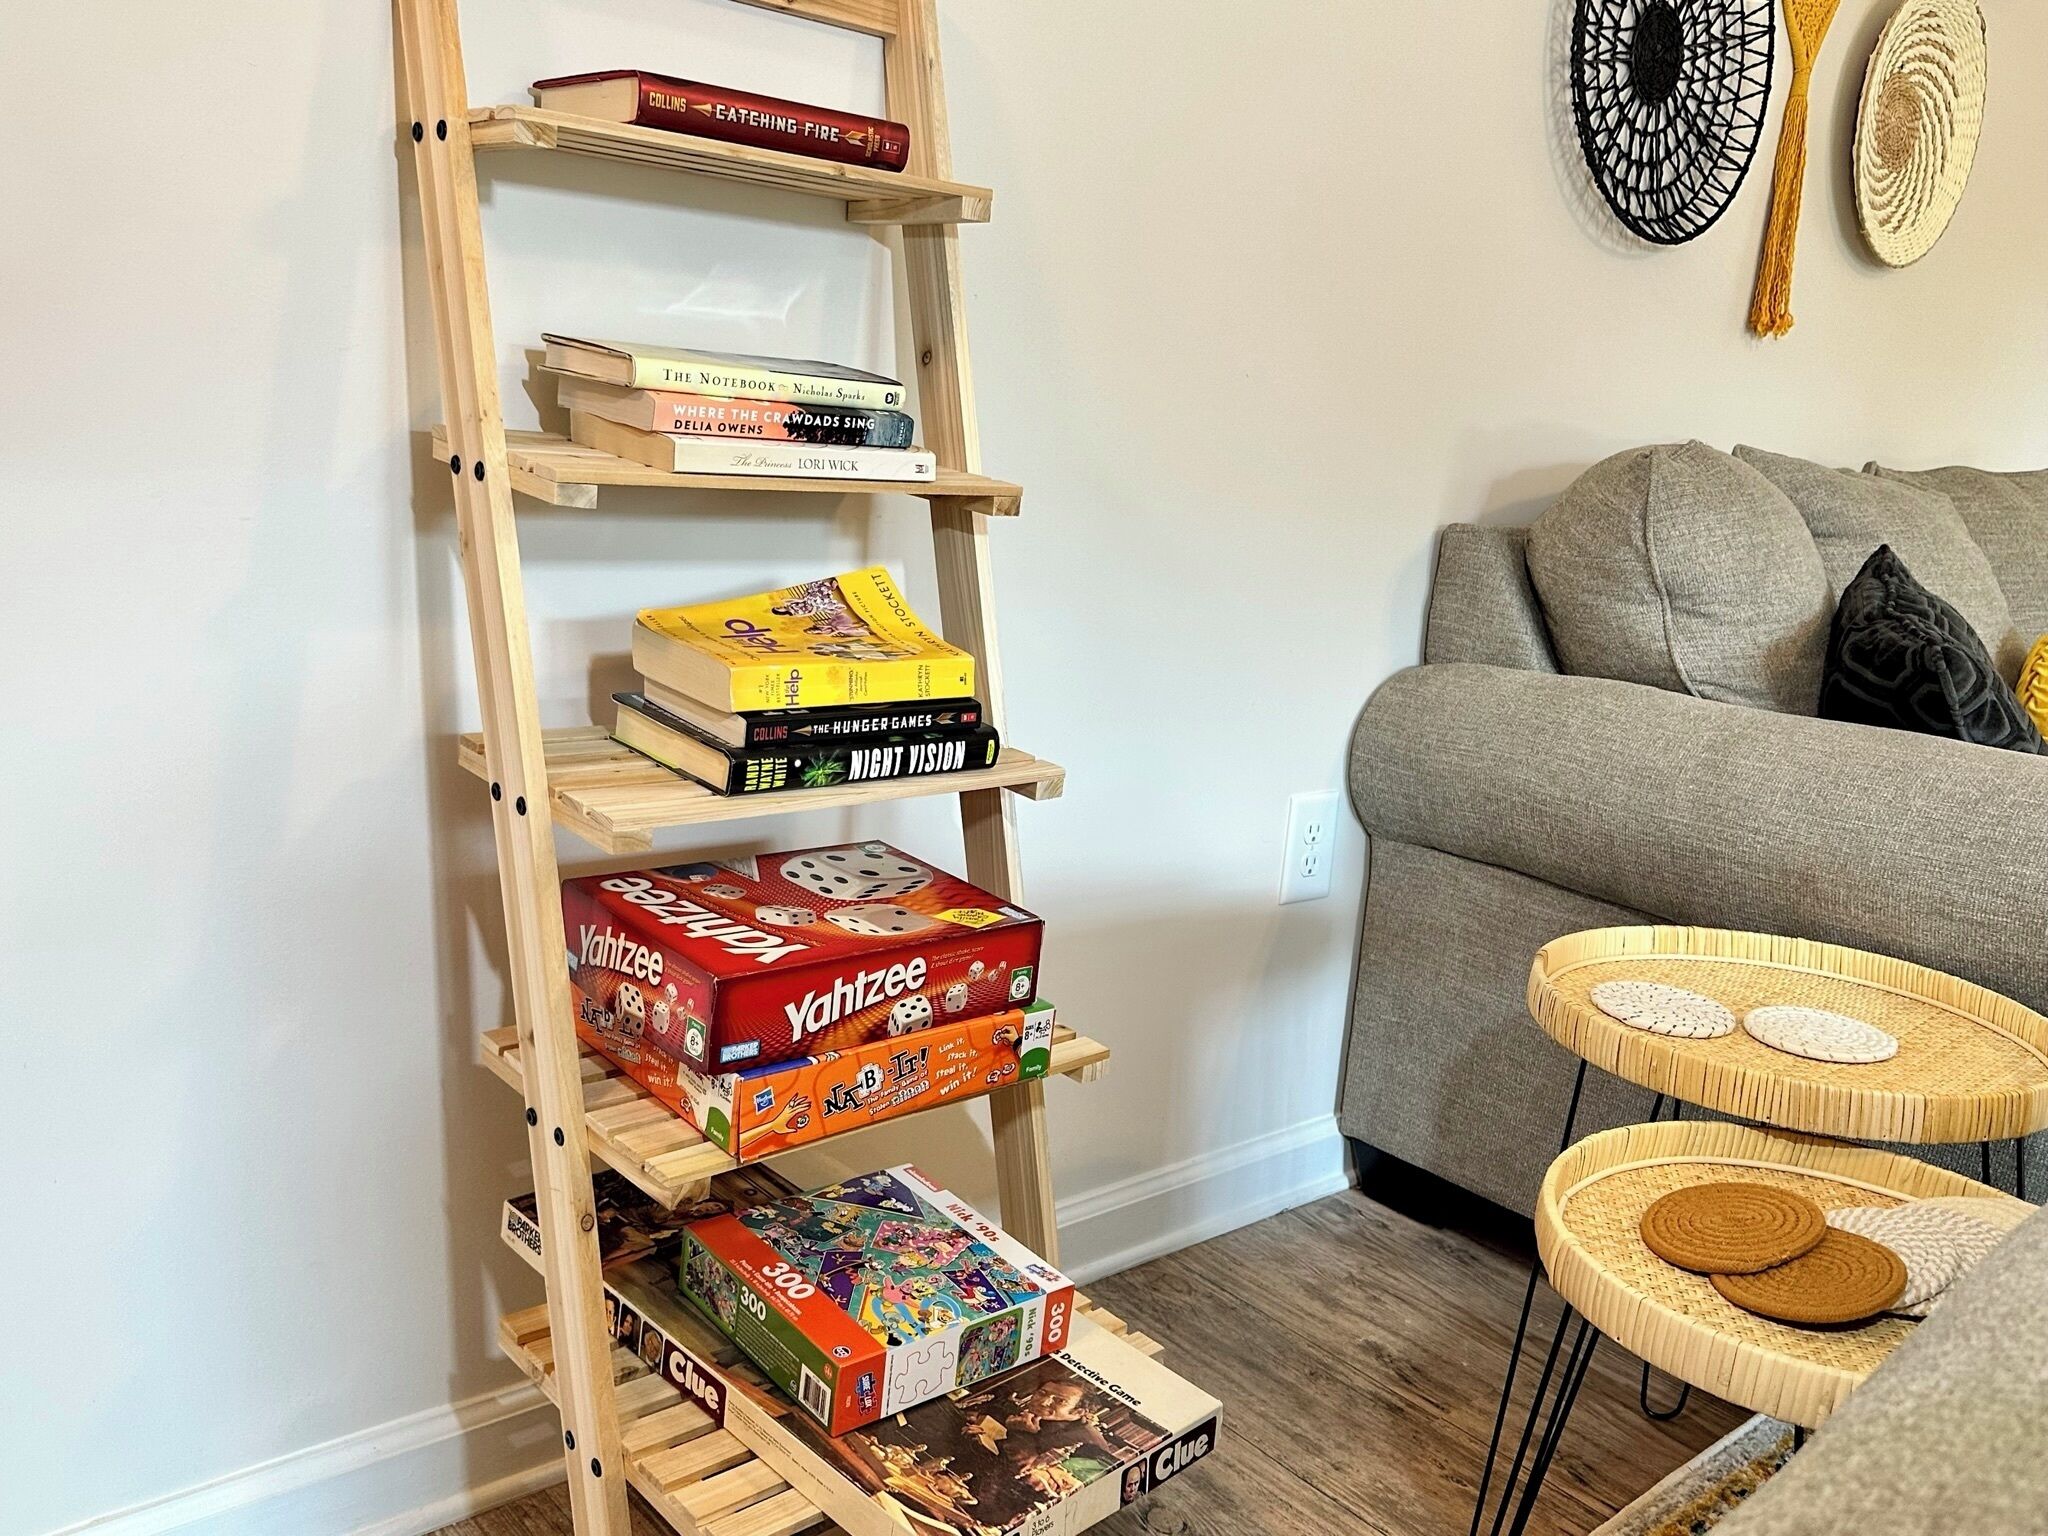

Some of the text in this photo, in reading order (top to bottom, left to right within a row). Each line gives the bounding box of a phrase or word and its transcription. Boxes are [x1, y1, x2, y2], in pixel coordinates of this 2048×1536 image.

[649, 91, 687, 112] COLLINS
[716, 104, 839, 142] CATCHING FIRE
[663, 369, 775, 392] THE NOTEBOOK
[793, 383, 865, 401] Nicholas Sparks
[673, 404, 875, 430] WHERE THE CRAWDADS SING
[674, 420, 763, 435] DELIA OWENS
[730, 452, 792, 469] The Princess
[798, 458, 859, 472] LORI WICK
[870, 574, 916, 627] STOCKETT
[719, 619, 800, 653] Help
[915, 631, 962, 656] KATHRYN
[784, 669, 803, 706] Help
[753, 725, 788, 741] COLLINS
[813, 714, 932, 734] THE HUNGER GAMES
[758, 757, 774, 790] WAYNE
[772, 757, 787, 788] WHITE
[848, 746, 904, 780] NIGHT
[908, 740, 966, 774] VISION
[744, 759, 760, 791] RANDY
[599, 877, 811, 964] Yahtzee
[580, 924, 663, 986] Yahtzee
[784, 957, 927, 1043] Yahtzee
[1015, 982, 1025, 992] 8+
[690, 1035, 699, 1047] 8+
[939, 1041, 955, 1053] Link
[722, 1050, 759, 1061] BROTHERS
[1025, 1064, 1041, 1073] Family
[663, 1074, 674, 1088] it!
[935, 1065, 956, 1079] Steal
[962, 1067, 977, 1082] it!
[867, 1096, 879, 1105] The
[880, 1085, 899, 1097] Family
[901, 1076, 918, 1087] Game
[869, 1101, 890, 1115] Stolen
[517, 1216, 541, 1243] PARKE
[946, 1203, 999, 1242] Nick '90s
[507, 1219, 542, 1256] BROTHERS
[762, 1262, 816, 1299] 300
[740, 1286, 766, 1321] 300
[1024, 1307, 1037, 1357] Nick '90s
[1048, 1302, 1065, 1343] 300
[669, 1350, 719, 1411] Clue
[1060, 1352, 1142, 1407] Detective Game
[1155, 1433, 1209, 1481] Clue
[1032, 1522, 1037, 1531] 3
[1045, 1515, 1050, 1523] 6
